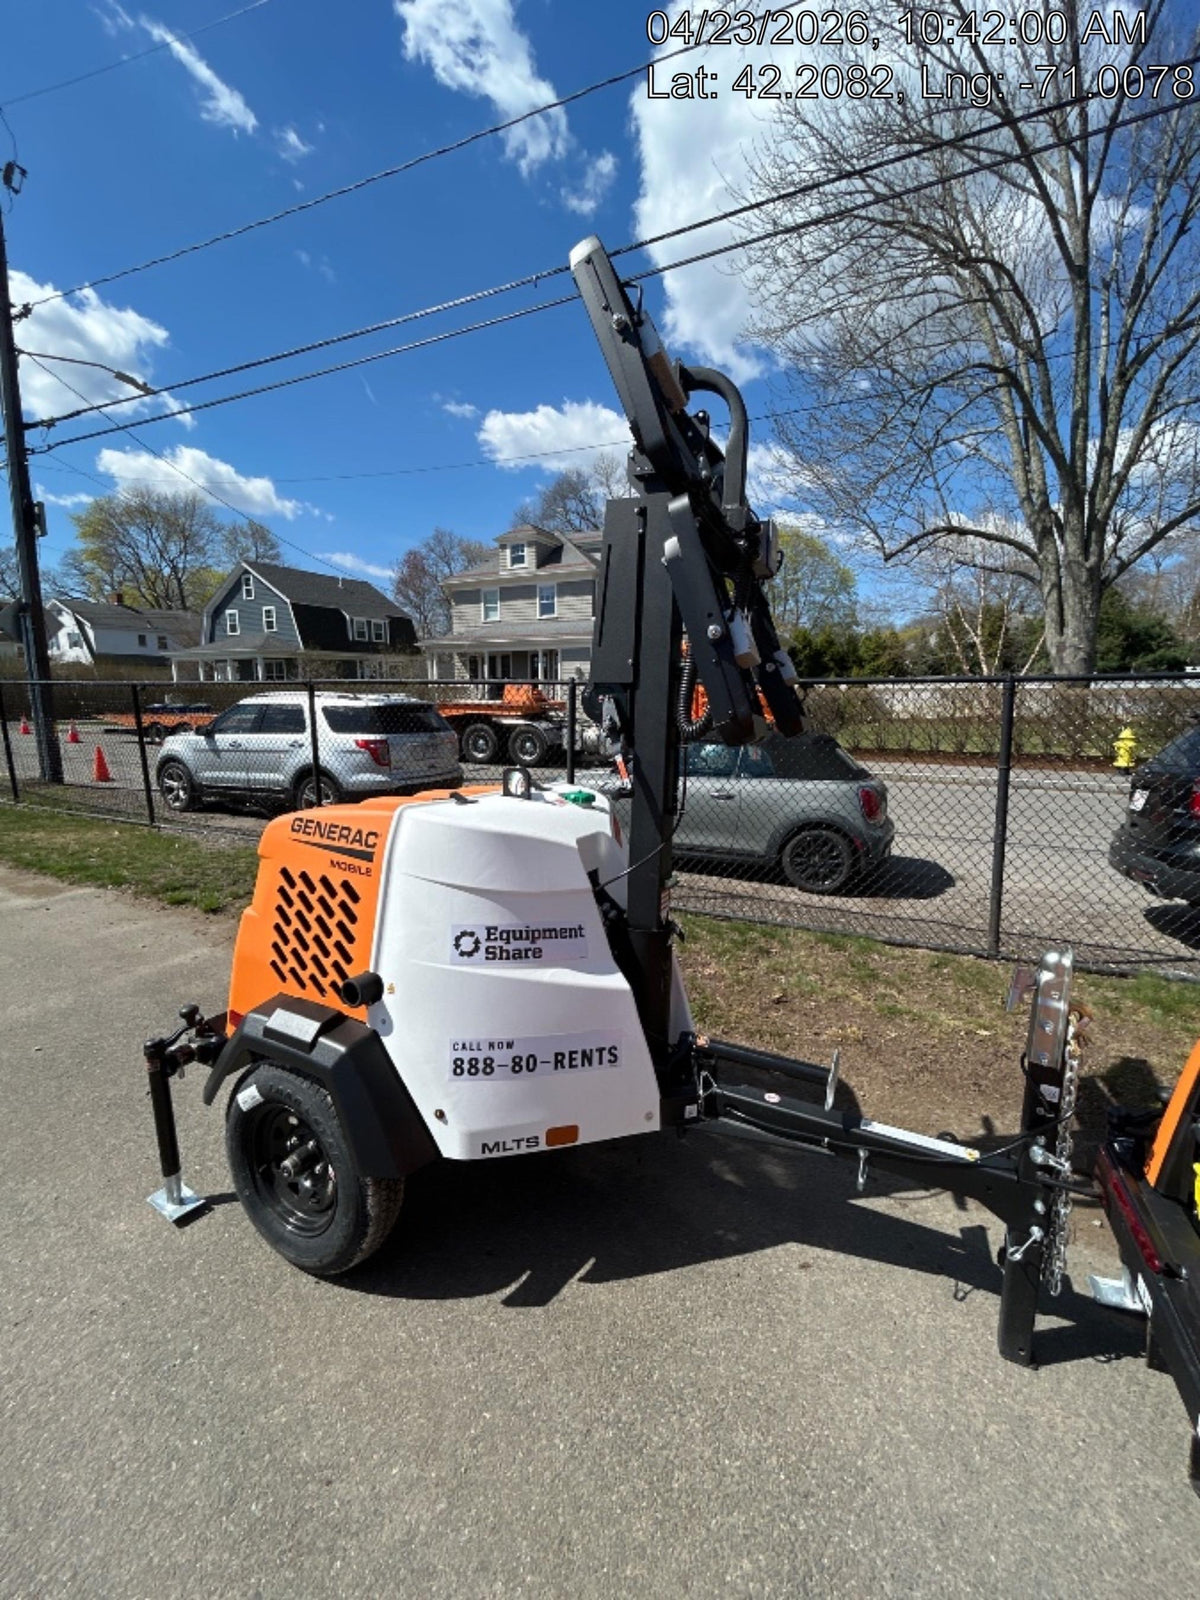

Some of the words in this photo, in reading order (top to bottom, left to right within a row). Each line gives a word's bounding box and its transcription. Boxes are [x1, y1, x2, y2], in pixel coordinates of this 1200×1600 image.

[291, 817, 379, 849] GENERAC
[330, 859, 372, 877] MOBILE
[484, 924, 586, 944] Equipment
[484, 945, 543, 961] Share
[452, 1041, 483, 1052] CALL
[488, 1039, 515, 1051] NOW
[452, 1045, 619, 1077] 888-80-RENTS
[481, 1136, 540, 1154] MLTS
